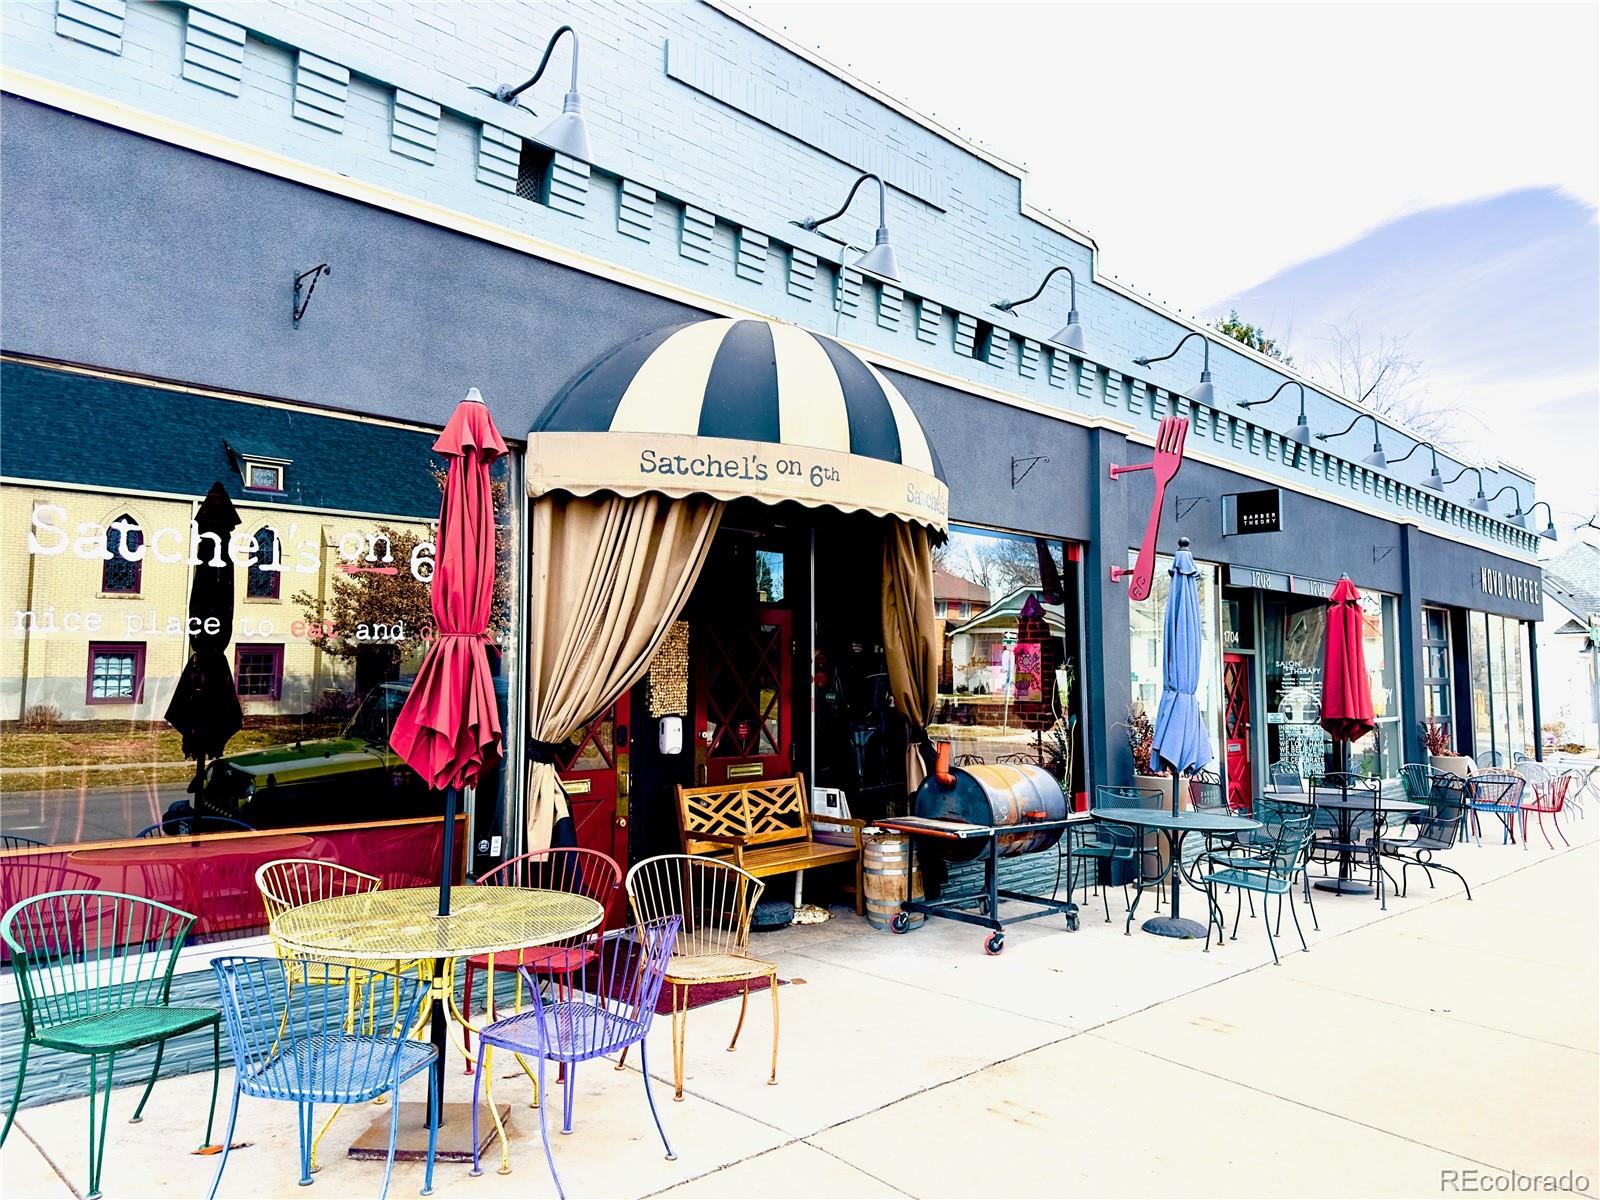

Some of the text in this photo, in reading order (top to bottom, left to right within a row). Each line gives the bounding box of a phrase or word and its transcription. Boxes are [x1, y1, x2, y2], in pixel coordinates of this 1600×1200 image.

[639, 449, 840, 488] Satchel's on 6th
[1243, 518, 1277, 527] THEORY
[28, 502, 322, 573] Satchel's
[338, 529, 395, 565] on
[1480, 565, 1540, 605] NOVO COFFEE
[15, 605, 103, 634] nice
[125, 610, 221, 639] place
[241, 617, 275, 638] to
[290, 619, 338, 639] eat
[355, 619, 406, 641] and
[1223, 631, 1239, 644] 1704
[1275, 660, 1301, 668] SALON
[1290, 667, 1321, 675] THERAPY
